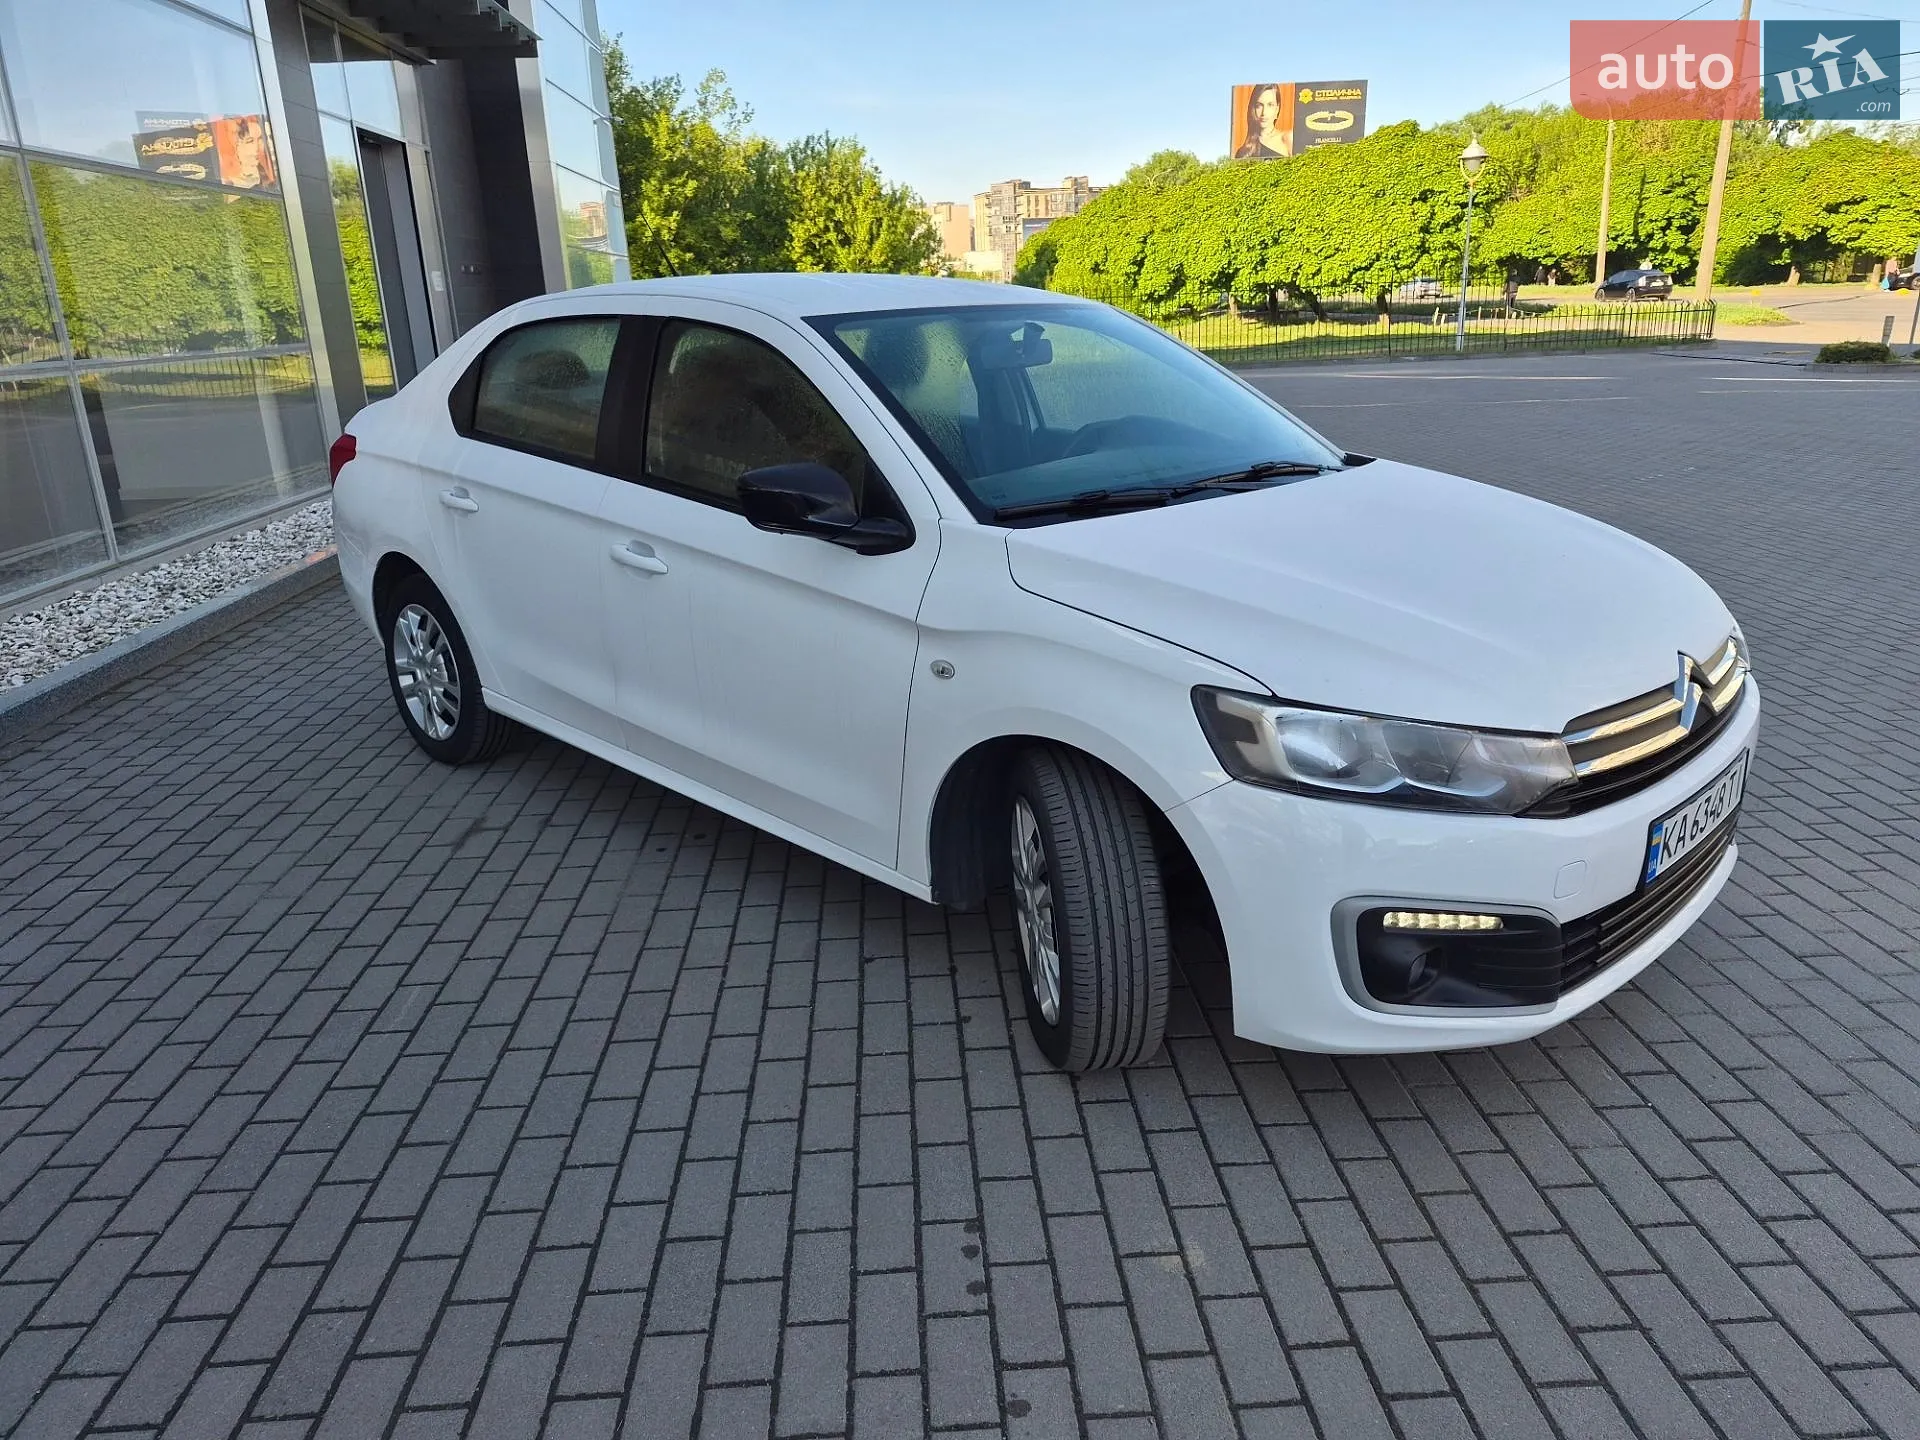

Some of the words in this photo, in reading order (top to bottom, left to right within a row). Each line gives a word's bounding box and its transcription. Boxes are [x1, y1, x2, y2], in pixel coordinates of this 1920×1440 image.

[1315, 88, 1362, 96] СТОЛИЧНА
[1660, 813, 1688, 865] KA
[1690, 782, 1727, 841] 6348
